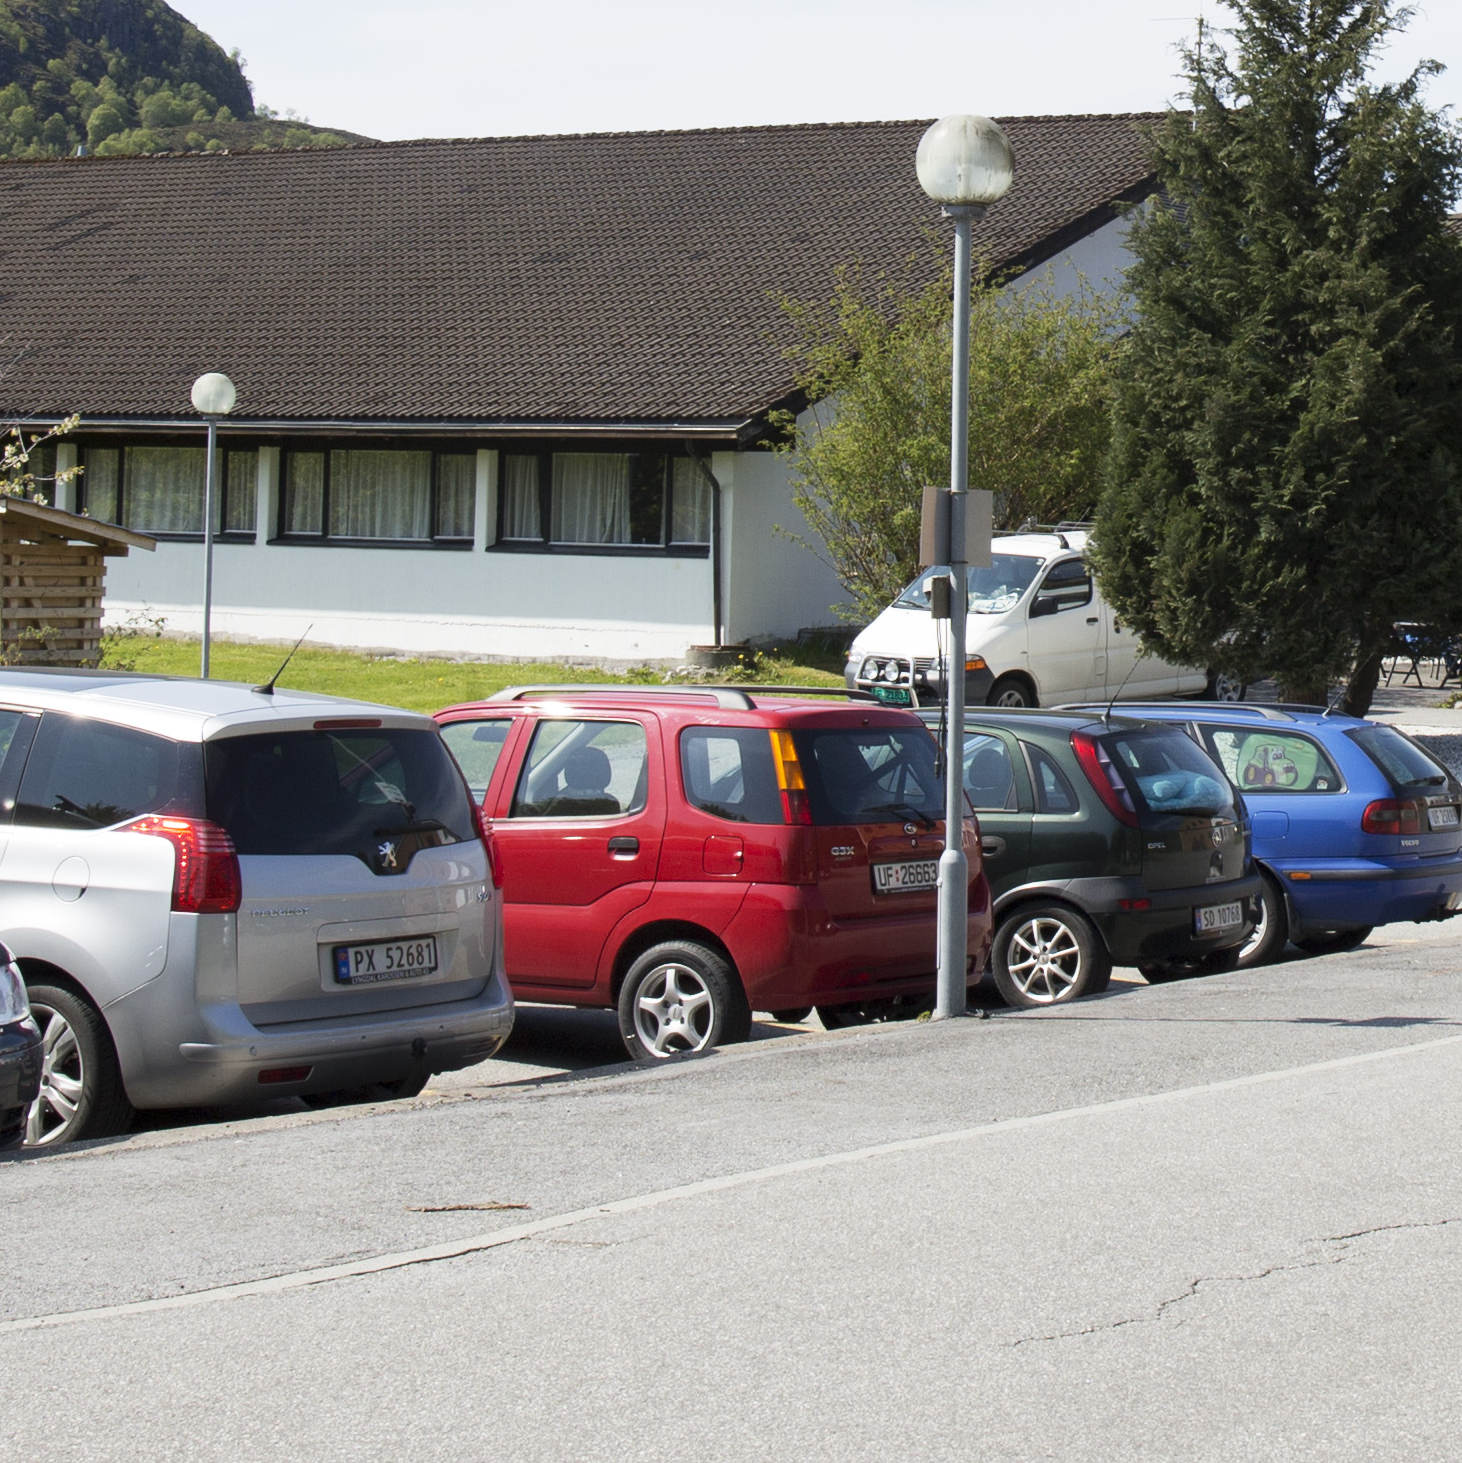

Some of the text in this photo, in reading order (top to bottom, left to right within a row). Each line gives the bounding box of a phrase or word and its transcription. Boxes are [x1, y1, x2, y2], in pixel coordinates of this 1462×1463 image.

[830, 846, 855, 856] G3X
[877, 862, 937, 887] UF 26663
[1203, 904, 1241, 928] SD 10768
[354, 942, 433, 973] PX 52681
